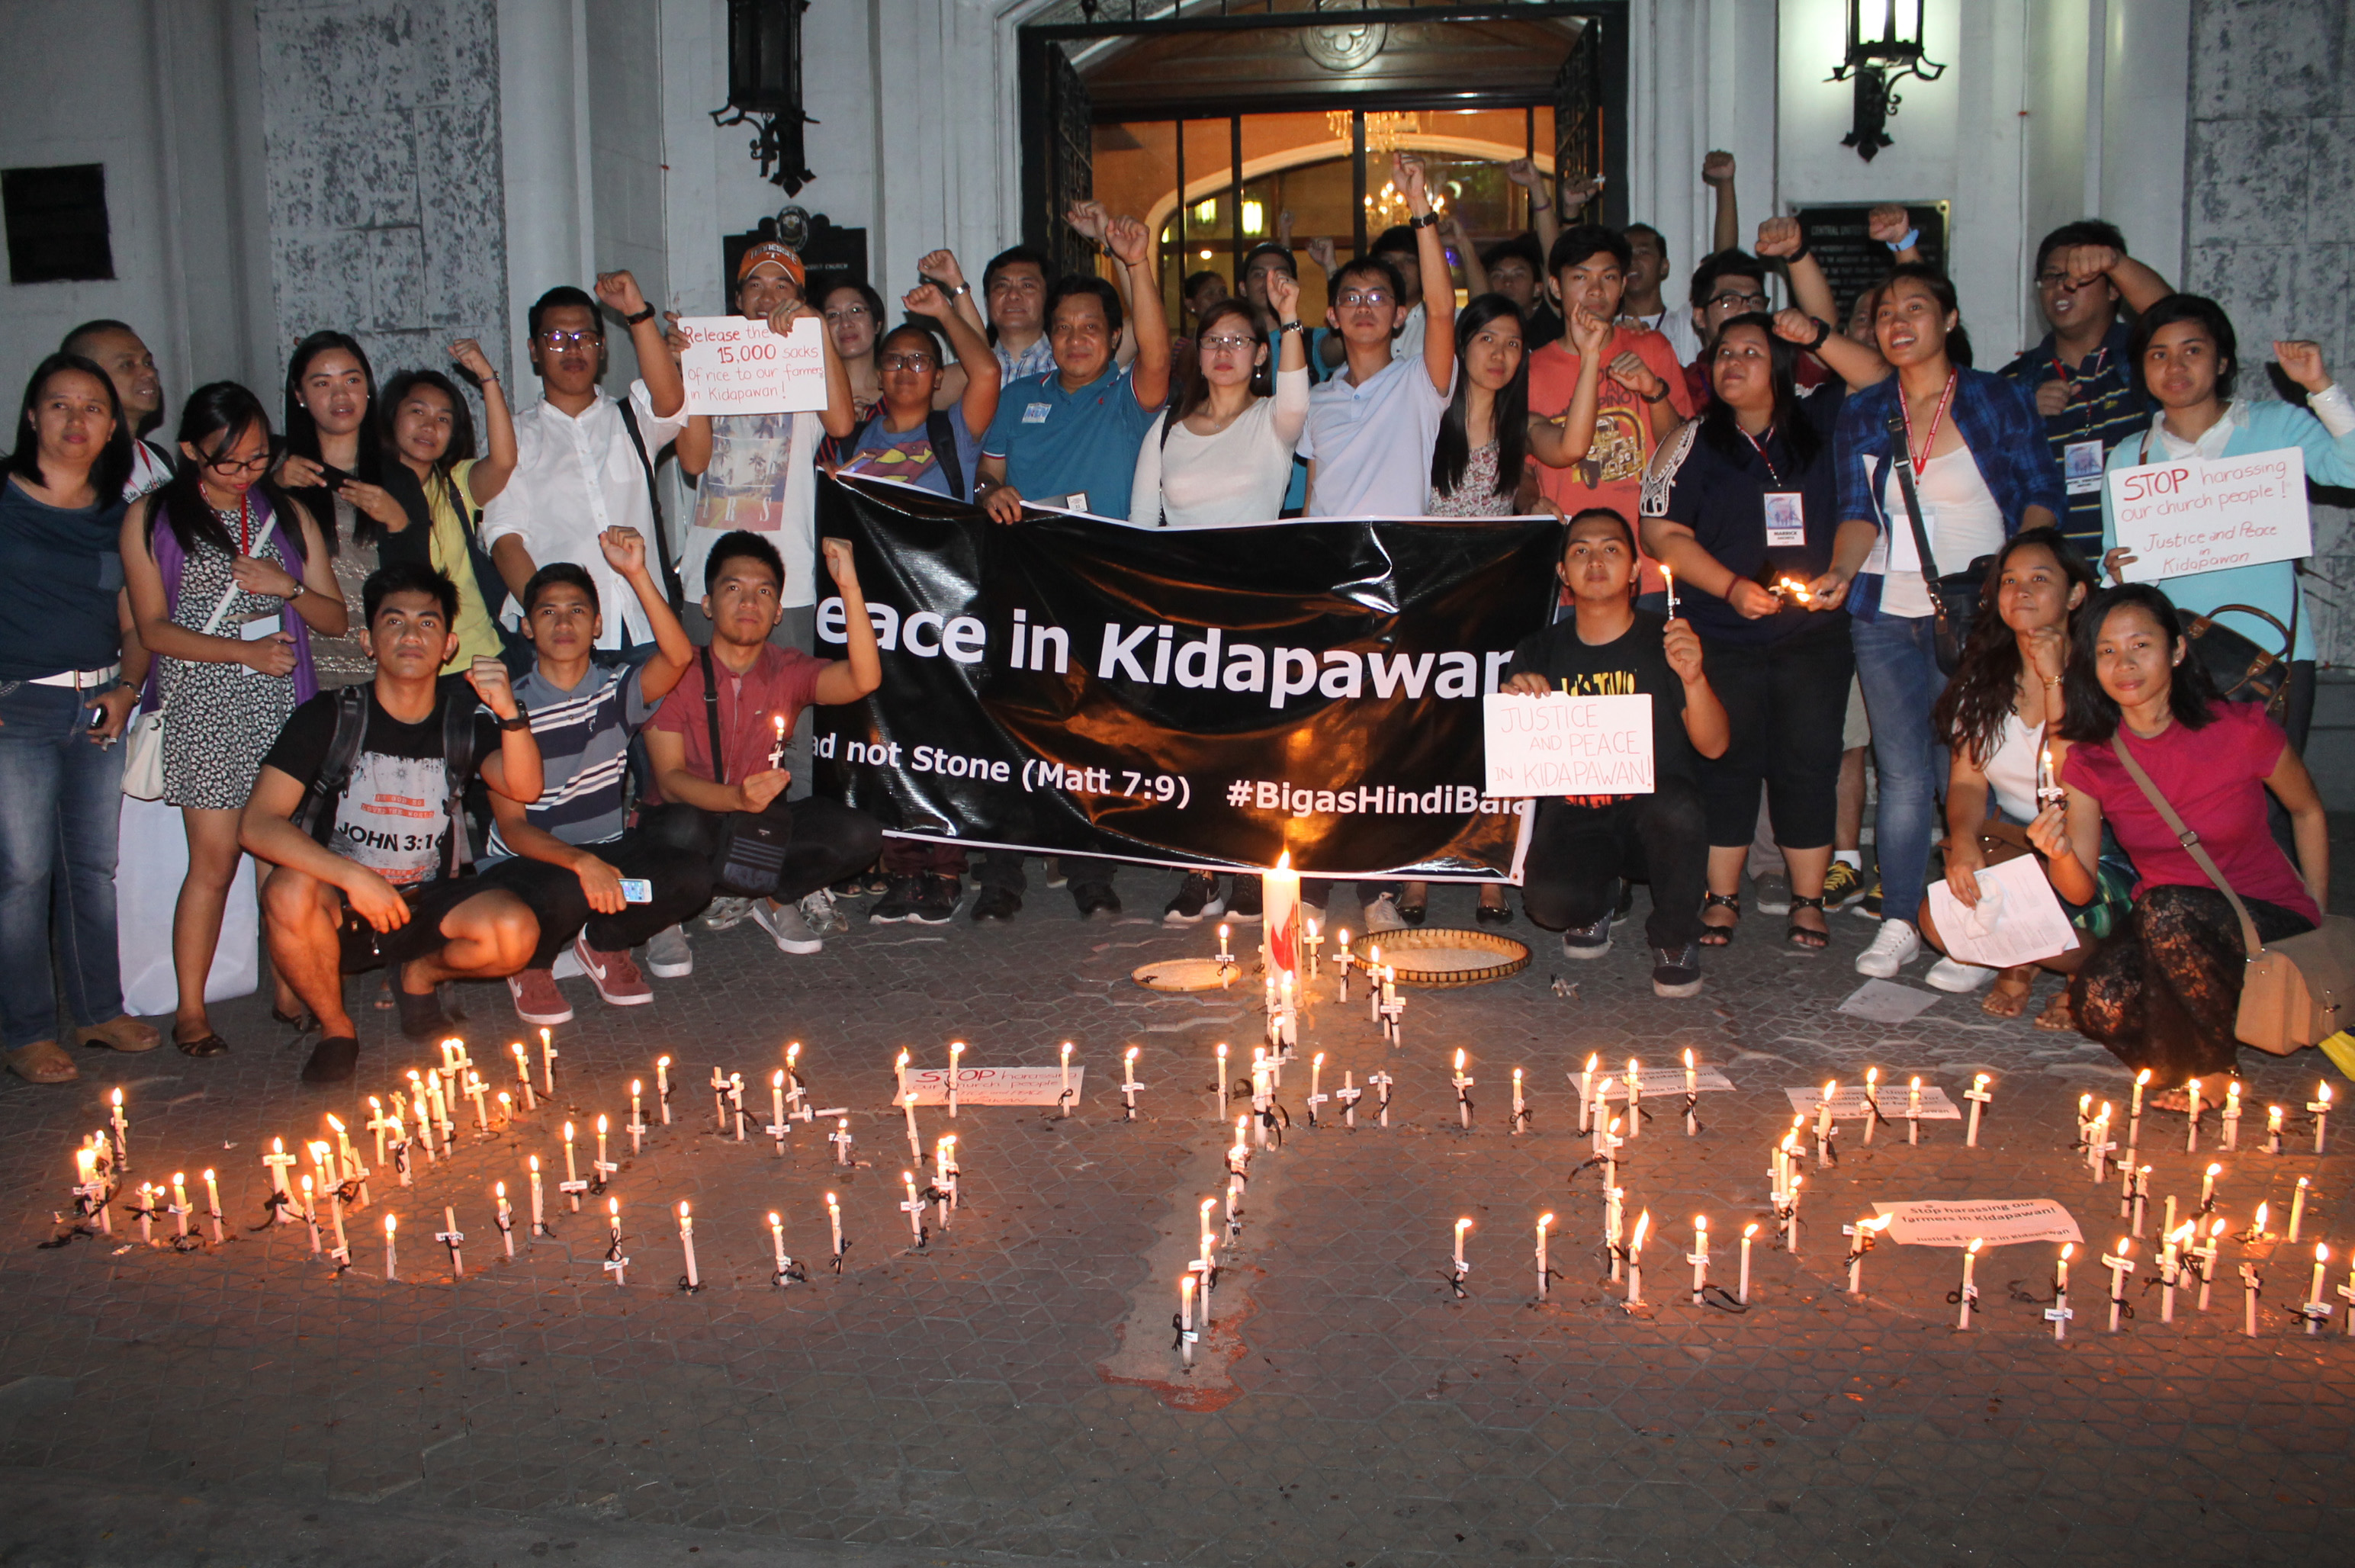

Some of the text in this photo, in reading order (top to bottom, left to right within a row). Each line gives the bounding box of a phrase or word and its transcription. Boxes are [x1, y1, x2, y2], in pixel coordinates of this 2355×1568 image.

[683, 325, 769, 343] Release the
[717, 344, 819, 364] 15,000 sacks
[706, 369, 729, 381] rice
[736, 368, 752, 380] to
[757, 368, 778, 378] our
[784, 364, 824, 381] farmers
[691, 390, 700, 400] in
[2124, 468, 2190, 501] STOP
[2199, 461, 2286, 486] harassing
[2121, 504, 2153, 522] our
[2157, 493, 2213, 516] church
[2144, 521, 2278, 551] Justice and Peace
[2163, 551, 2251, 574] Kidapawan
[2199, 546, 2211, 556] in
[817, 596, 985, 664] eace
[1010, 609, 1068, 674] in
[1501, 704, 1598, 733] JUSTICE
[1529, 731, 1640, 757] AND PEACE
[847, 741, 902, 768] not
[911, 745, 1010, 783] Stone
[1022, 758, 1119, 795] (Matt
[1122, 772, 1191, 810] 7:9)
[1495, 754, 1652, 790] IN KIDAPAWAN!
[338, 821, 398, 852] JOHN
[1010, 1079, 1059, 1089] people
[1901, 1215, 1956, 1223] farmers
[1975, 1207, 2056, 1222] Kidapawan!
[1910, 1201, 2035, 1215] Stop harassing our
